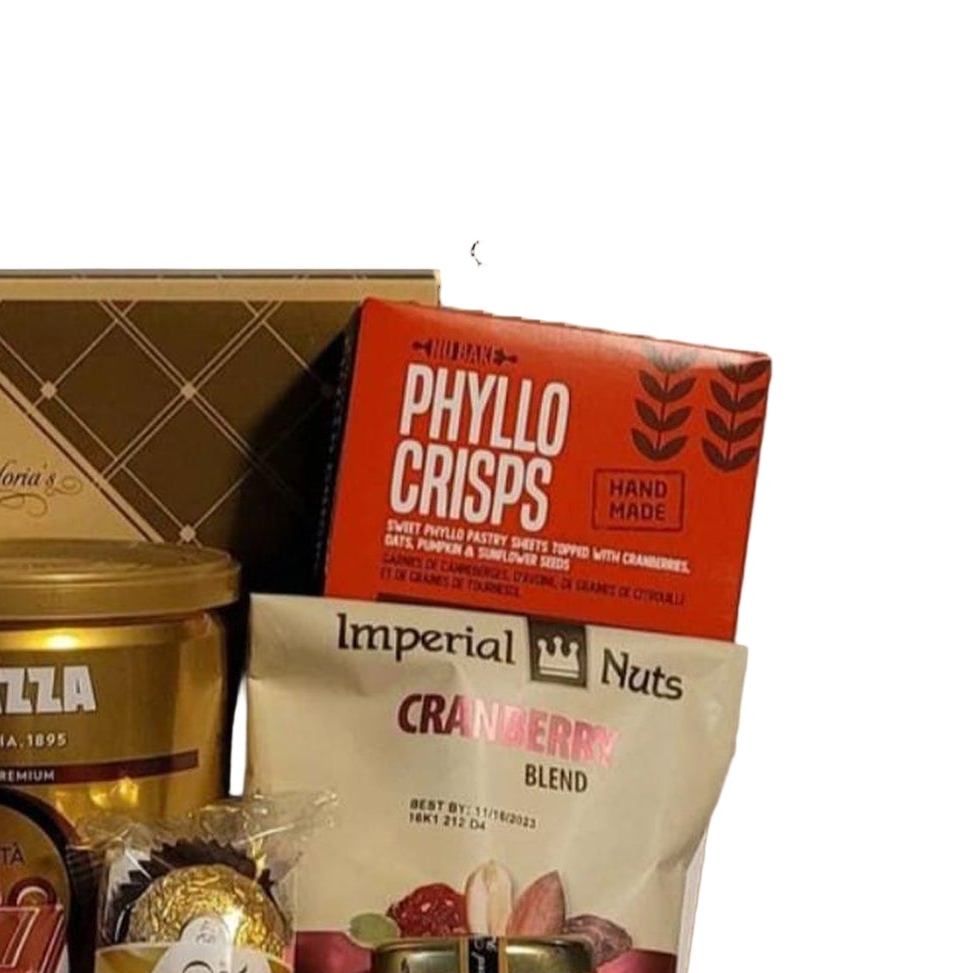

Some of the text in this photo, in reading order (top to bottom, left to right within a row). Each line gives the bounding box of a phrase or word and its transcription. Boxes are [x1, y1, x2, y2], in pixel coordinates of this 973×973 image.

[399, 362, 570, 457] PHYLLO
[389, 439, 552, 533] CRISPS
[610, 478, 667, 498] HAND
[609, 501, 666, 521] MADE
[386, 519, 422, 535] SWEET
[423, 524, 465, 542] PHYLLO
[466, 529, 508, 547] PASTRY
[511, 536, 549, 553] SHEETS
[552, 541, 590, 559] TOPPED
[592, 547, 621, 564] WITH
[417, 538, 462, 556] PUMPKIN
[464, 545, 474, 558] &
[478, 547, 538, 566] SUNFLOWER
[539, 555, 570, 571] SEEDS
[337, 612, 684, 701] Imperial Nuts
[28, 732, 67, 747] 1895
[397, 692, 621, 768] CRANBERRY
[525, 763, 588, 793] BLEND
[410, 798, 444, 811] BEST
[448, 801, 471, 816] BY:
